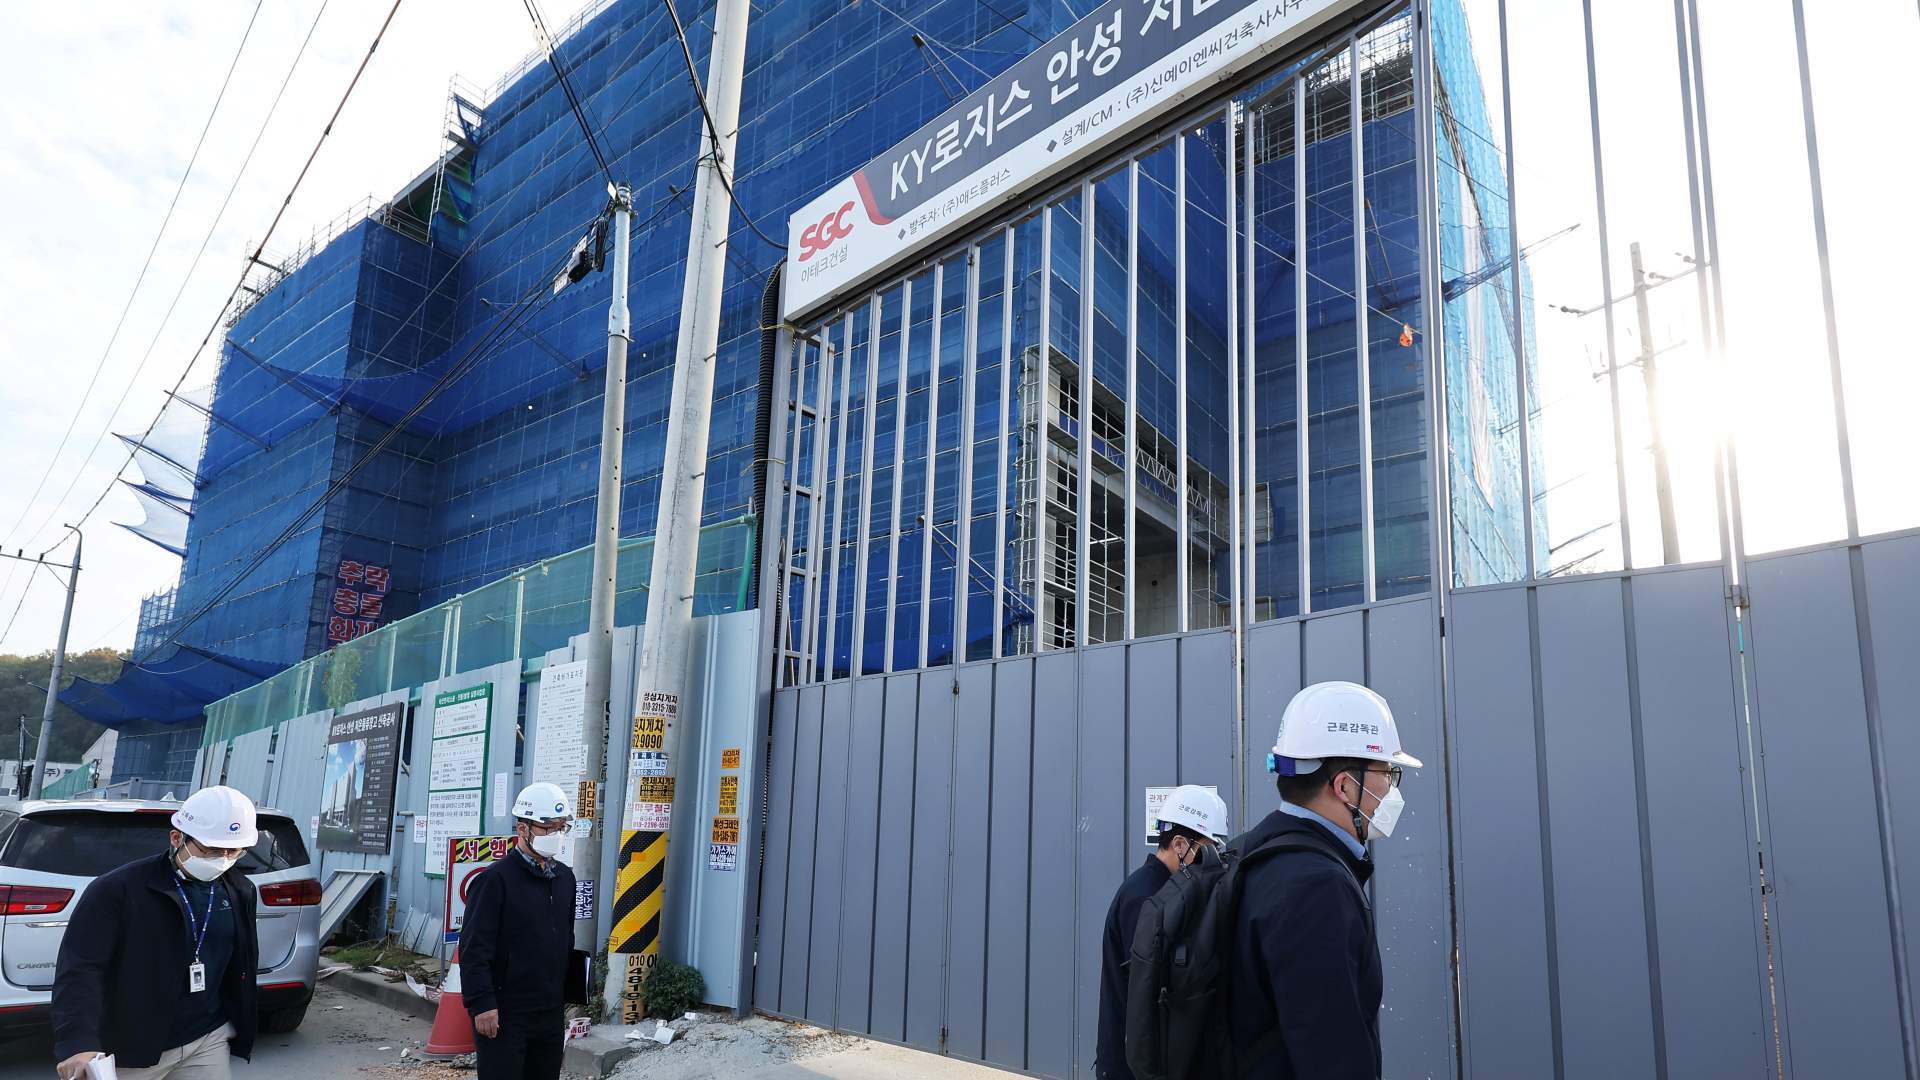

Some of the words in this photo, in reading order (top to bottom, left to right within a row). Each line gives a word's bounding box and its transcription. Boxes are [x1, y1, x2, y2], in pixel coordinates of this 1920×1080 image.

[889, 80, 1033, 201] KY로지스
[1046, 8, 1122, 105] 안성
[1062, 108, 1114, 146] 설계/CM
[909, 207, 940, 236] 발주자:
[942, 167, 1012, 218] (주)애드플러스
[798, 201, 856, 262] SGC
[800, 243, 849, 283] 이테크건설
[338, 560, 389, 592] 추락
[333, 587, 382, 619] 충돌
[1327, 721, 1379, 736] 근로감독관
[585, 781, 596, 818] 사다리차
[1178, 803, 1209, 820] 근로감독관
[629, 954, 645, 967] 010
